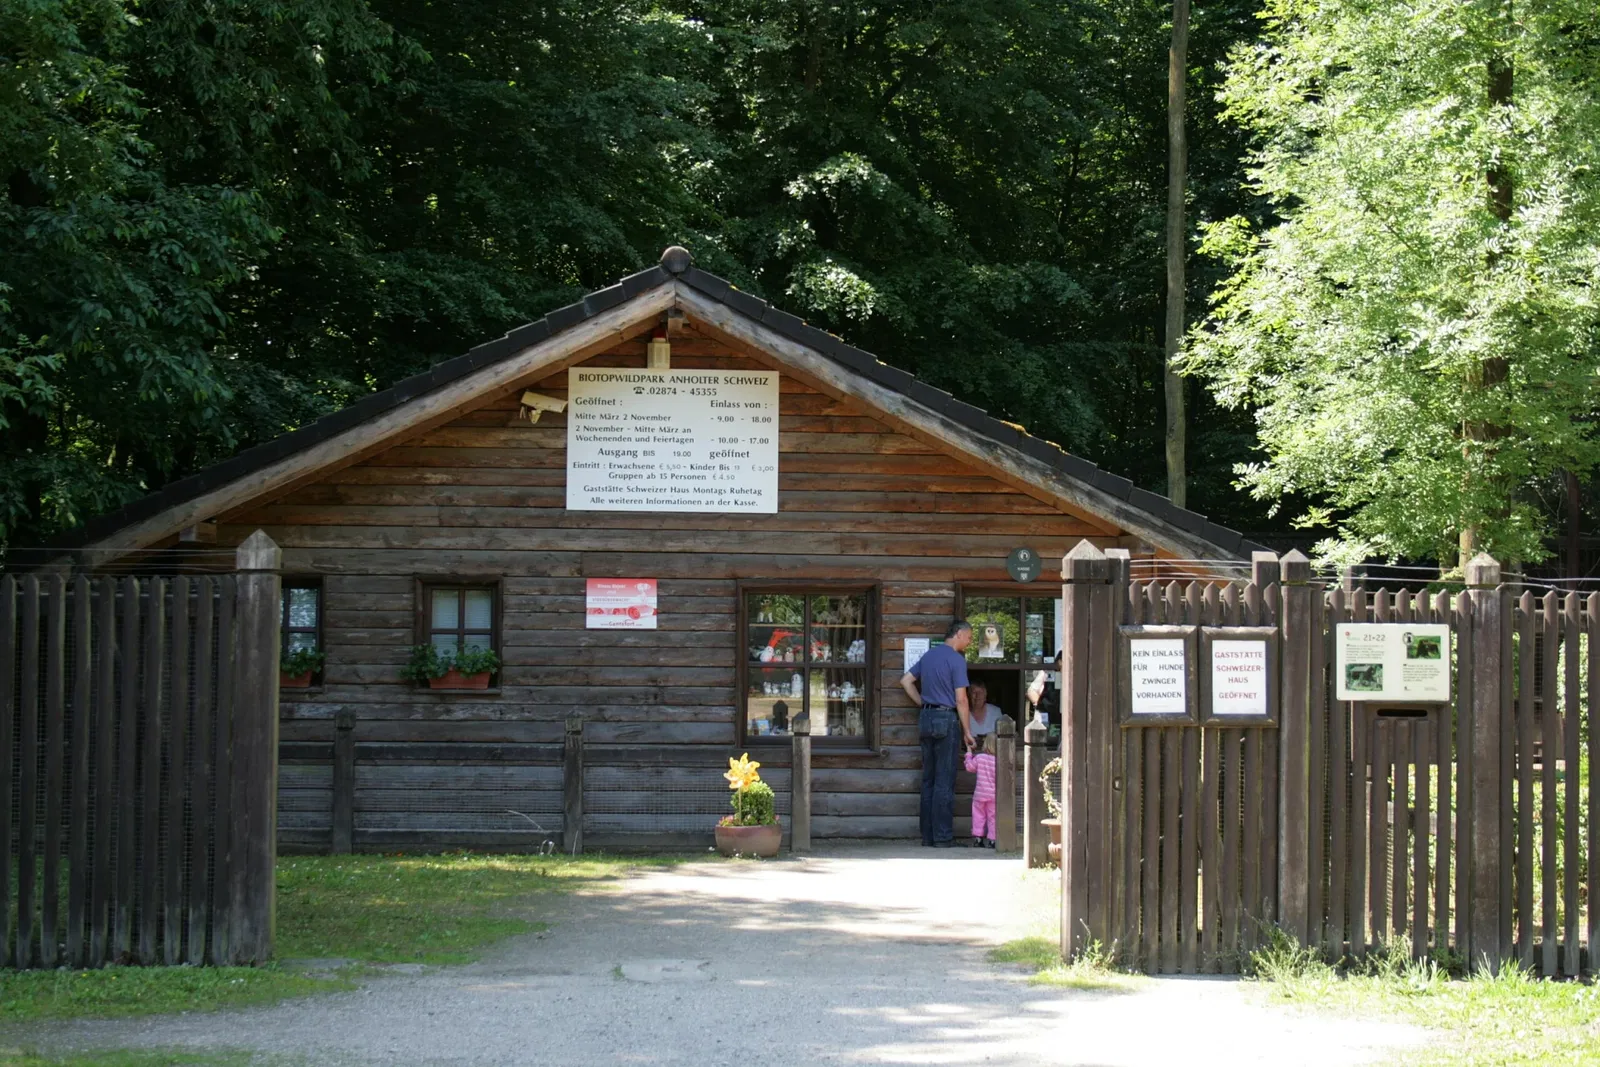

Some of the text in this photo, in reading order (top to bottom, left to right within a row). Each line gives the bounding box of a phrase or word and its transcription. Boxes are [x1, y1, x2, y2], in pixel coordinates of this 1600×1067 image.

[578, 373, 769, 386] BIOTOPWILDPARK ANHOLTER SCHWEIZ
[690, 388, 717, 396] 45355
[575, 396, 616, 406] Geöffnet
[710, 399, 741, 408] Einlass
[575, 412, 596, 420] Mitte
[599, 412, 619, 420] März
[623, 413, 628, 421] 2
[631, 413, 671, 421] November
[717, 415, 734, 423] 9.00
[583, 425, 624, 433] November
[659, 426, 679, 434] März
[575, 434, 632, 442] Wochenenden
[653, 436, 695, 445] Feiertagen
[749, 437, 769, 445] 17.00
[598, 447, 640, 458] Ausgang
[709, 449, 750, 460] geöffnet
[572, 461, 600, 469] Eintritt
[608, 462, 656, 470] Erwachsene
[690, 463, 716, 471] Kinder
[719, 463, 730, 471] Bis
[608, 472, 643, 481] Gruppen
[646, 472, 656, 480] ab
[670, 473, 707, 481] Personen
[583, 485, 624, 493] Gaststätte
[626, 485, 667, 493] Schweizer
[693, 486, 727, 496] Montags
[730, 487, 763, 496] Ruhetag
[608, 497, 643, 505] weiteren
[646, 497, 702, 506] Informationen
[717, 498, 731, 506] der
[1152, 649, 1184, 657] EINLASS
[1133, 663, 1148, 671] FÜR
[1141, 677, 1177, 685] ZWINGER
[1228, 676, 1249, 684] HAUS
[1136, 691, 1182, 699] VORHANDEN
[1218, 691, 1257, 699] GEÖFFNET
